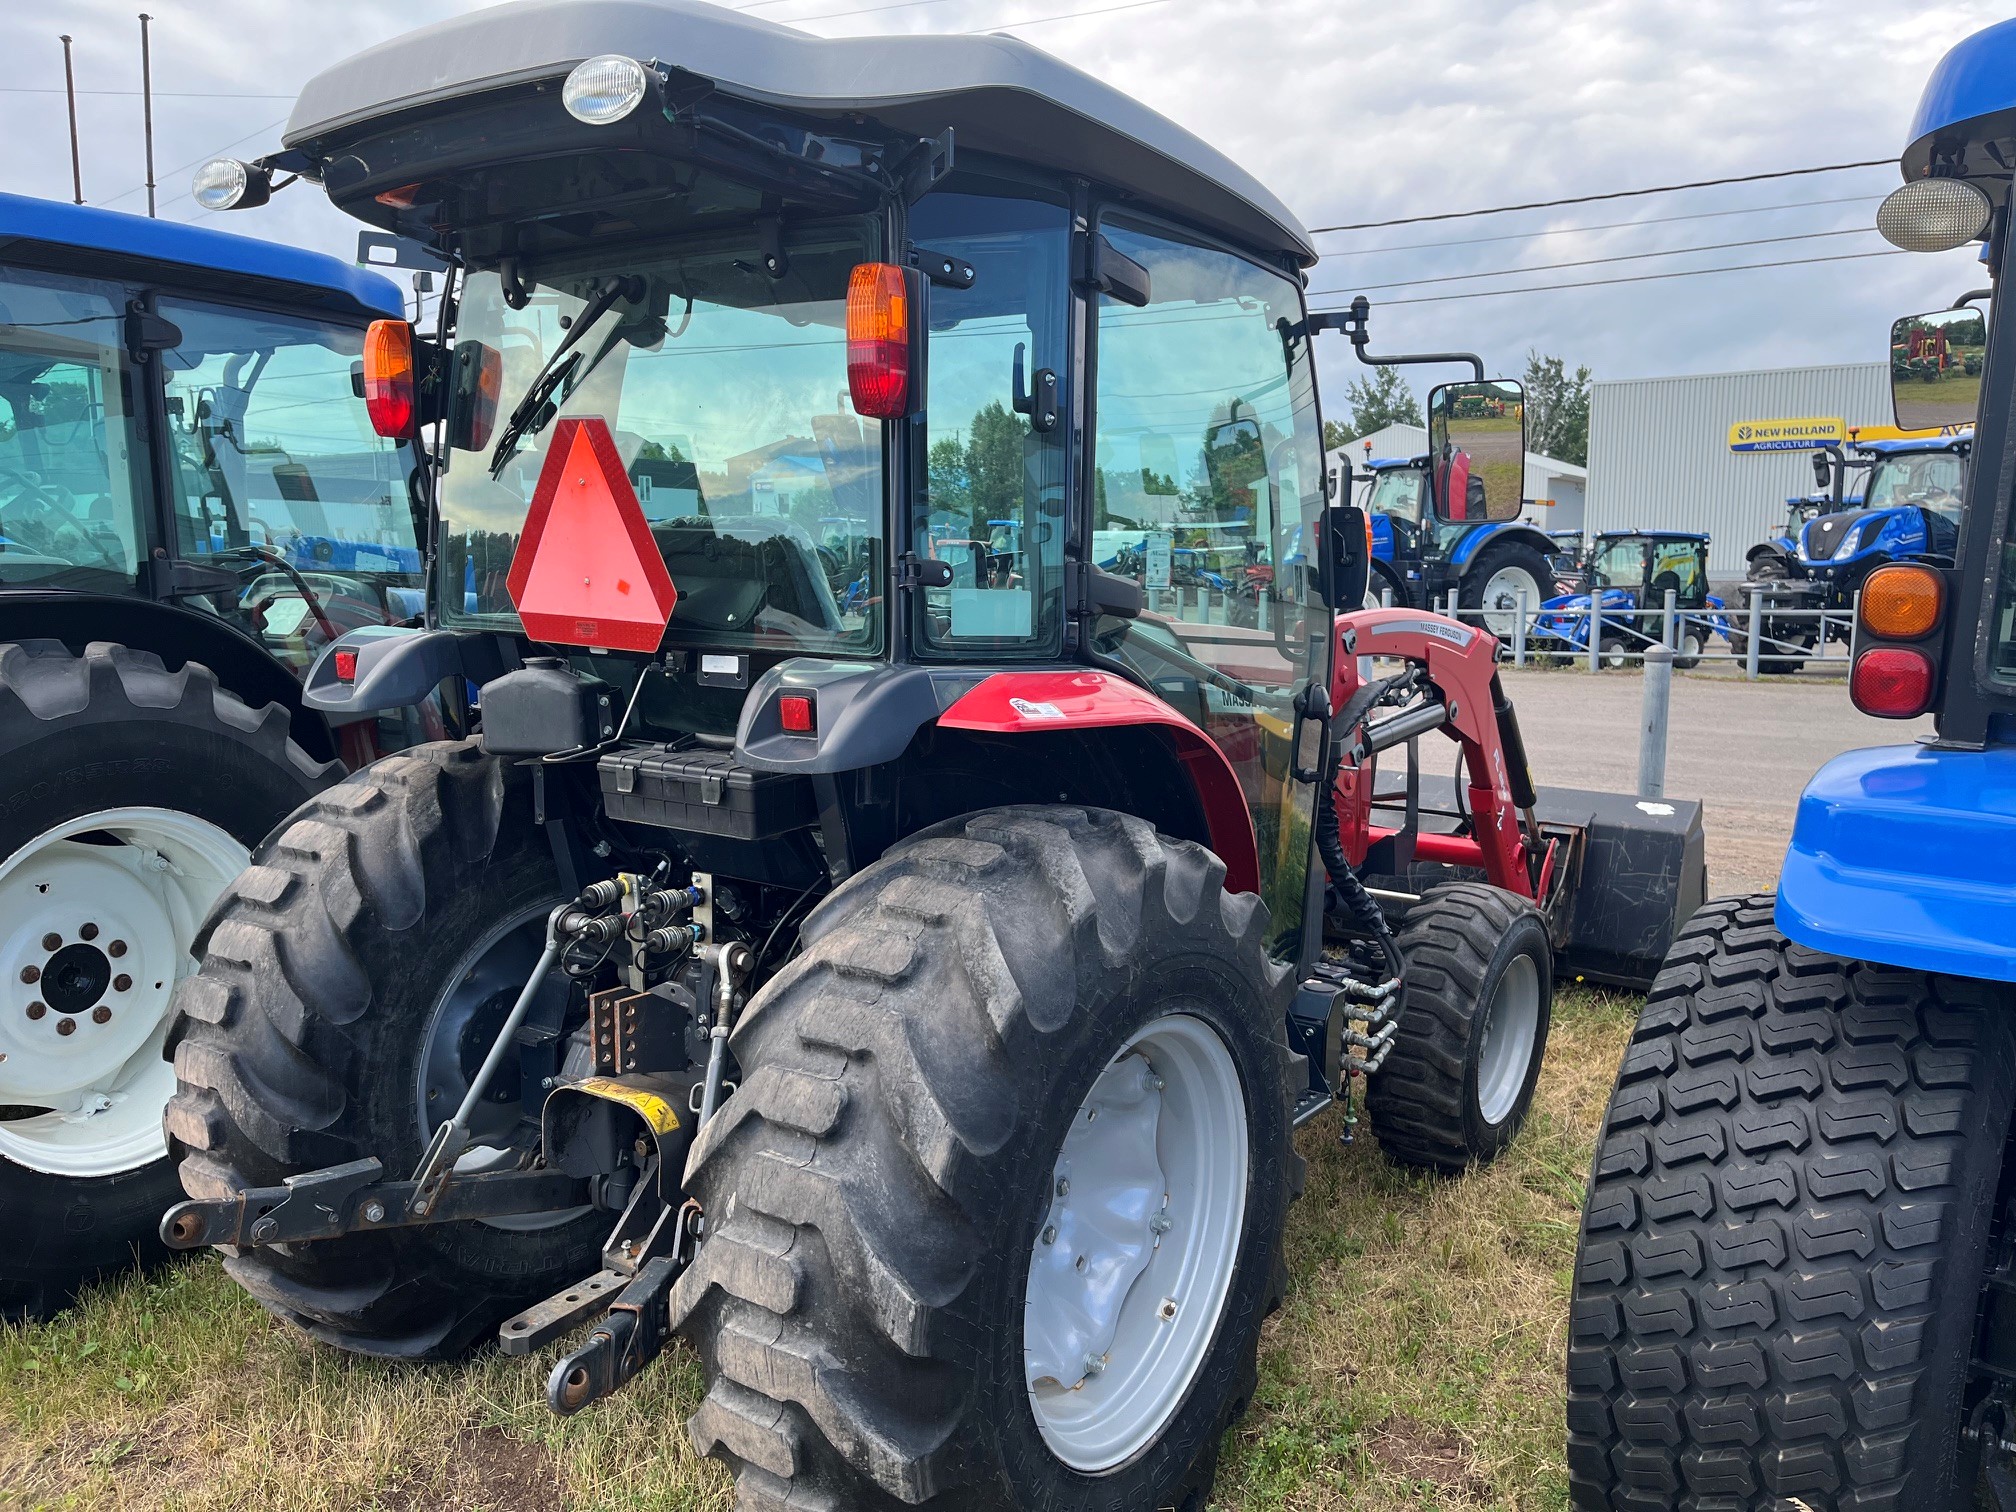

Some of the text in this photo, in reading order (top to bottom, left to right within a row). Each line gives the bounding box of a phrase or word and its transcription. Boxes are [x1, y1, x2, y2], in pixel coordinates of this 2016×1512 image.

[1755, 425, 1835, 438] NEW HOLLAND
[1939, 424, 1973, 437] AV
[1753, 439, 1816, 451] AGRICULTURE
[1420, 622, 1462, 642] MASSEY FERGUSON
